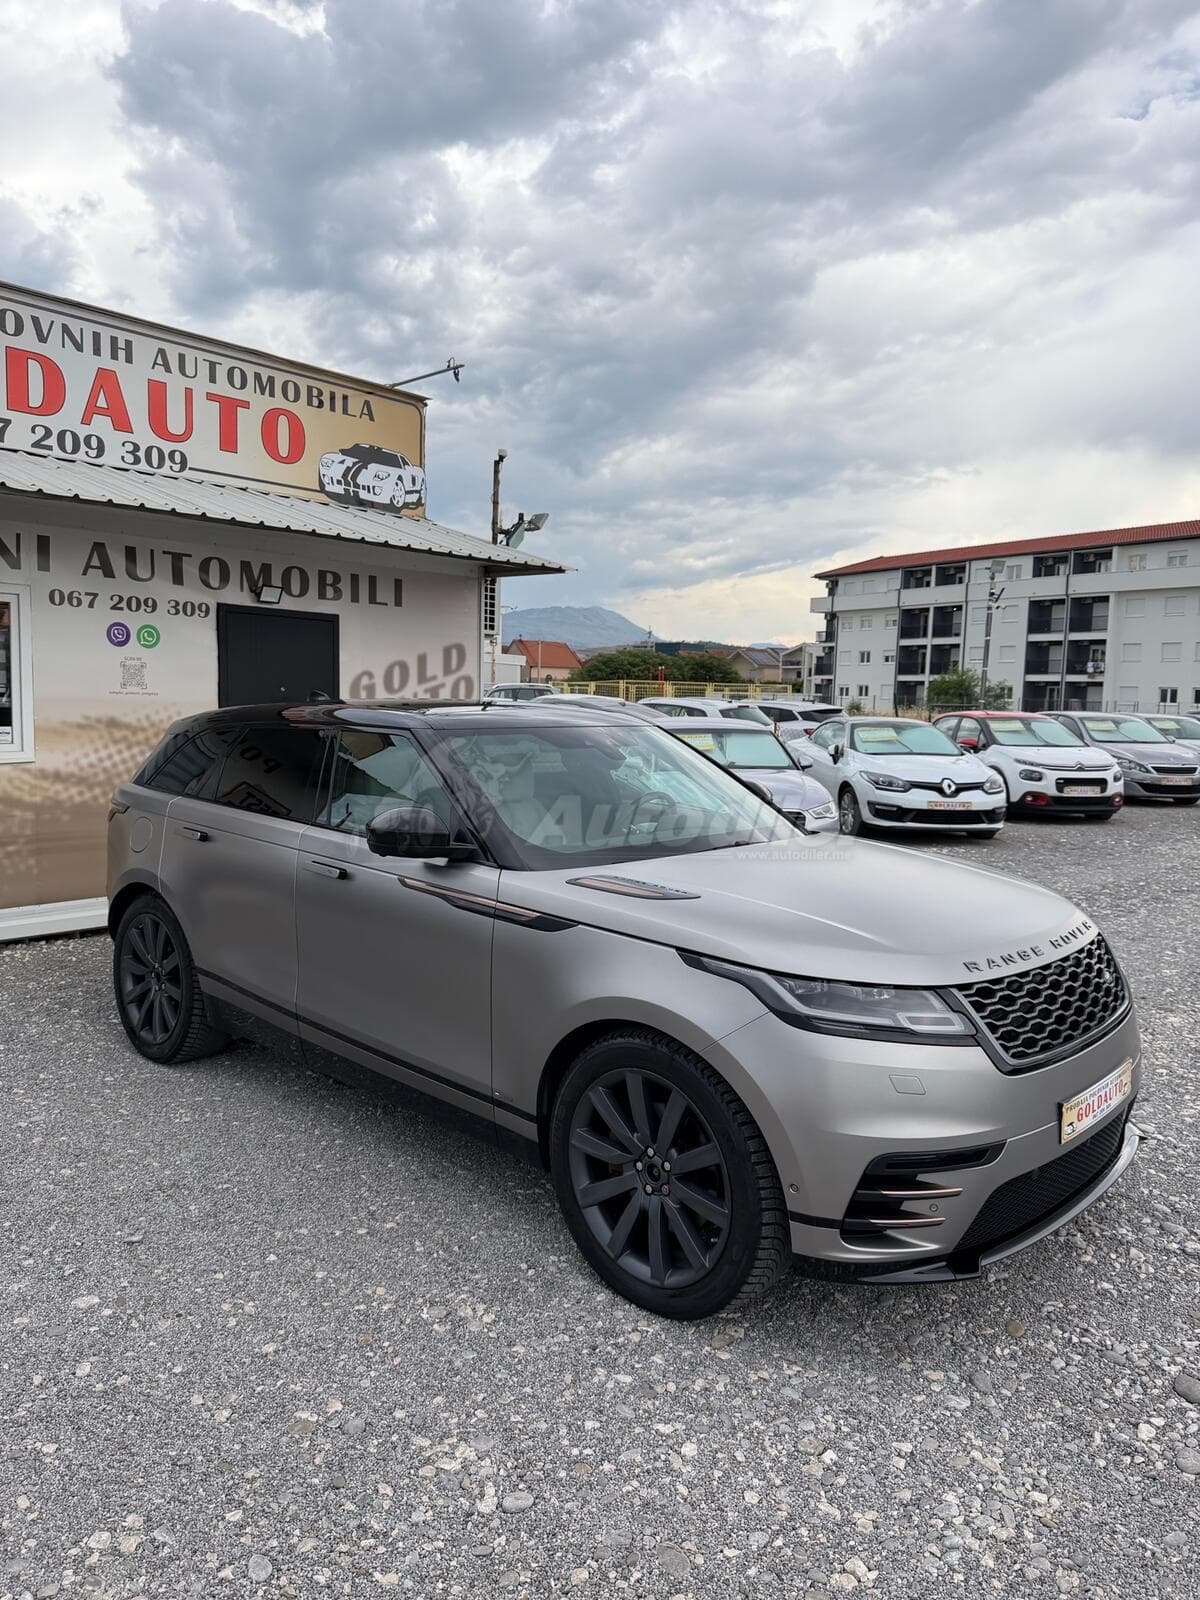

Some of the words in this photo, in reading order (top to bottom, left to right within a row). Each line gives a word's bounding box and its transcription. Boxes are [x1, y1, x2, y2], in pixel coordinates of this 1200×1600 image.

[0, 308, 133, 364] OVNIH
[151, 347, 375, 422] AUTOMOBILA
[5, 345, 306, 465] DAUTO
[30, 424, 105, 459] 209
[121, 440, 188, 473] 309
[0, 532, 50, 572] NI
[81, 541, 403, 607] AUTOMOBILI
[49, 588, 99, 609] 067
[109, 594, 158, 613] 209
[167, 600, 210, 618] 309
[349, 642, 466, 699] GOLD
[962, 945, 1045, 973] RANGE
[1048, 920, 1092, 949] ROVER
[1077, 1078, 1124, 1122] GOLDAUTO
